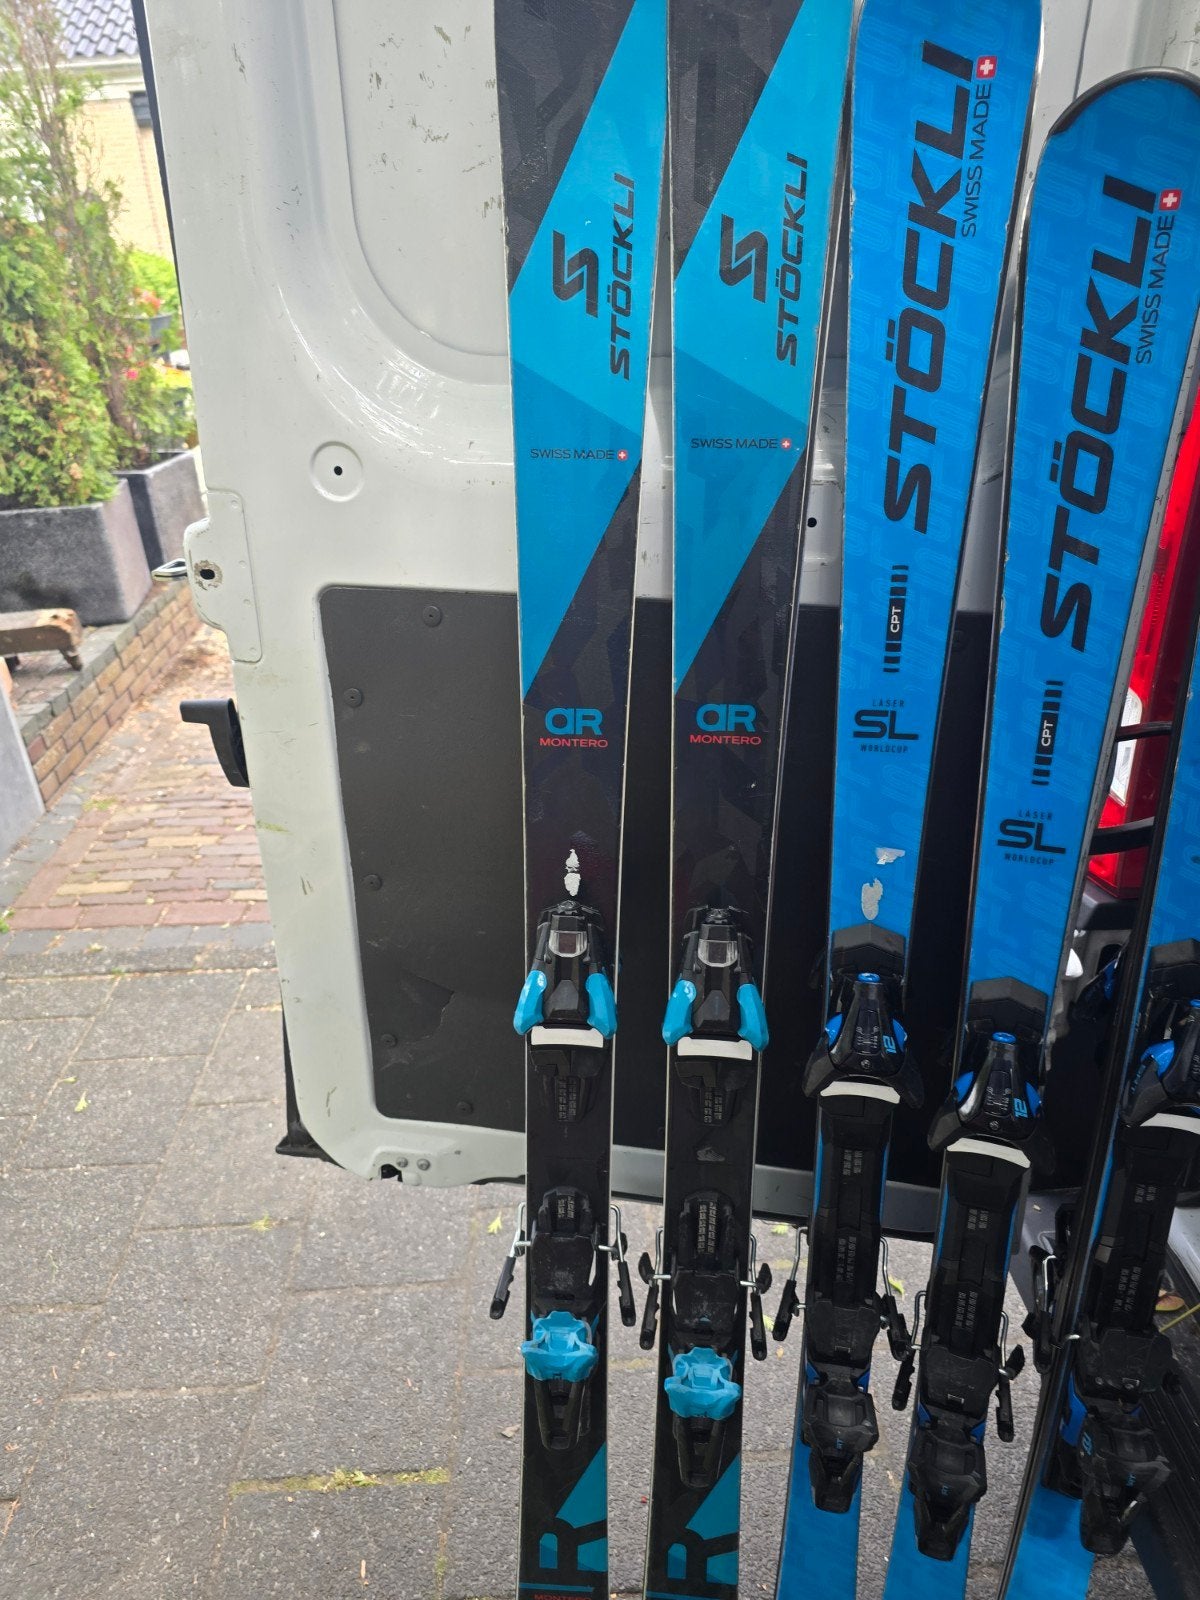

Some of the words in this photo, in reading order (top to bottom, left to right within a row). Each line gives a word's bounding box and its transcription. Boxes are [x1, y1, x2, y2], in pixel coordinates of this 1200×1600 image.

[969, 83, 991, 160] MADE
[962, 165, 983, 237] SWISS
[775, 152, 808, 367] STÖCKLI
[1147, 215, 1175, 289] MADE
[606, 172, 635, 381] STÖCKLI
[883, 39, 974, 535] STÖCKLI
[1135, 294, 1161, 364] SWISS
[1040, 174, 1157, 653] STÖCKLI
[530, 448, 571, 459] SWISS
[573, 449, 614, 460] MADE
[690, 438, 733, 449] SWISS
[735, 438, 778, 449] MADE
[890, 606, 902, 633] CPT
[872, 699, 906, 708] LASER
[853, 709, 919, 741] SL
[1041, 720, 1054, 747] CPT
[539, 737, 609, 749] MONTERO
[689, 734, 762, 746] MONTERO
[860, 744, 909, 754] WORLDCUP
[1017, 809, 1053, 821] LASER
[997, 818, 1066, 855] SL
[1004, 852, 1055, 865] WORLDCUP
